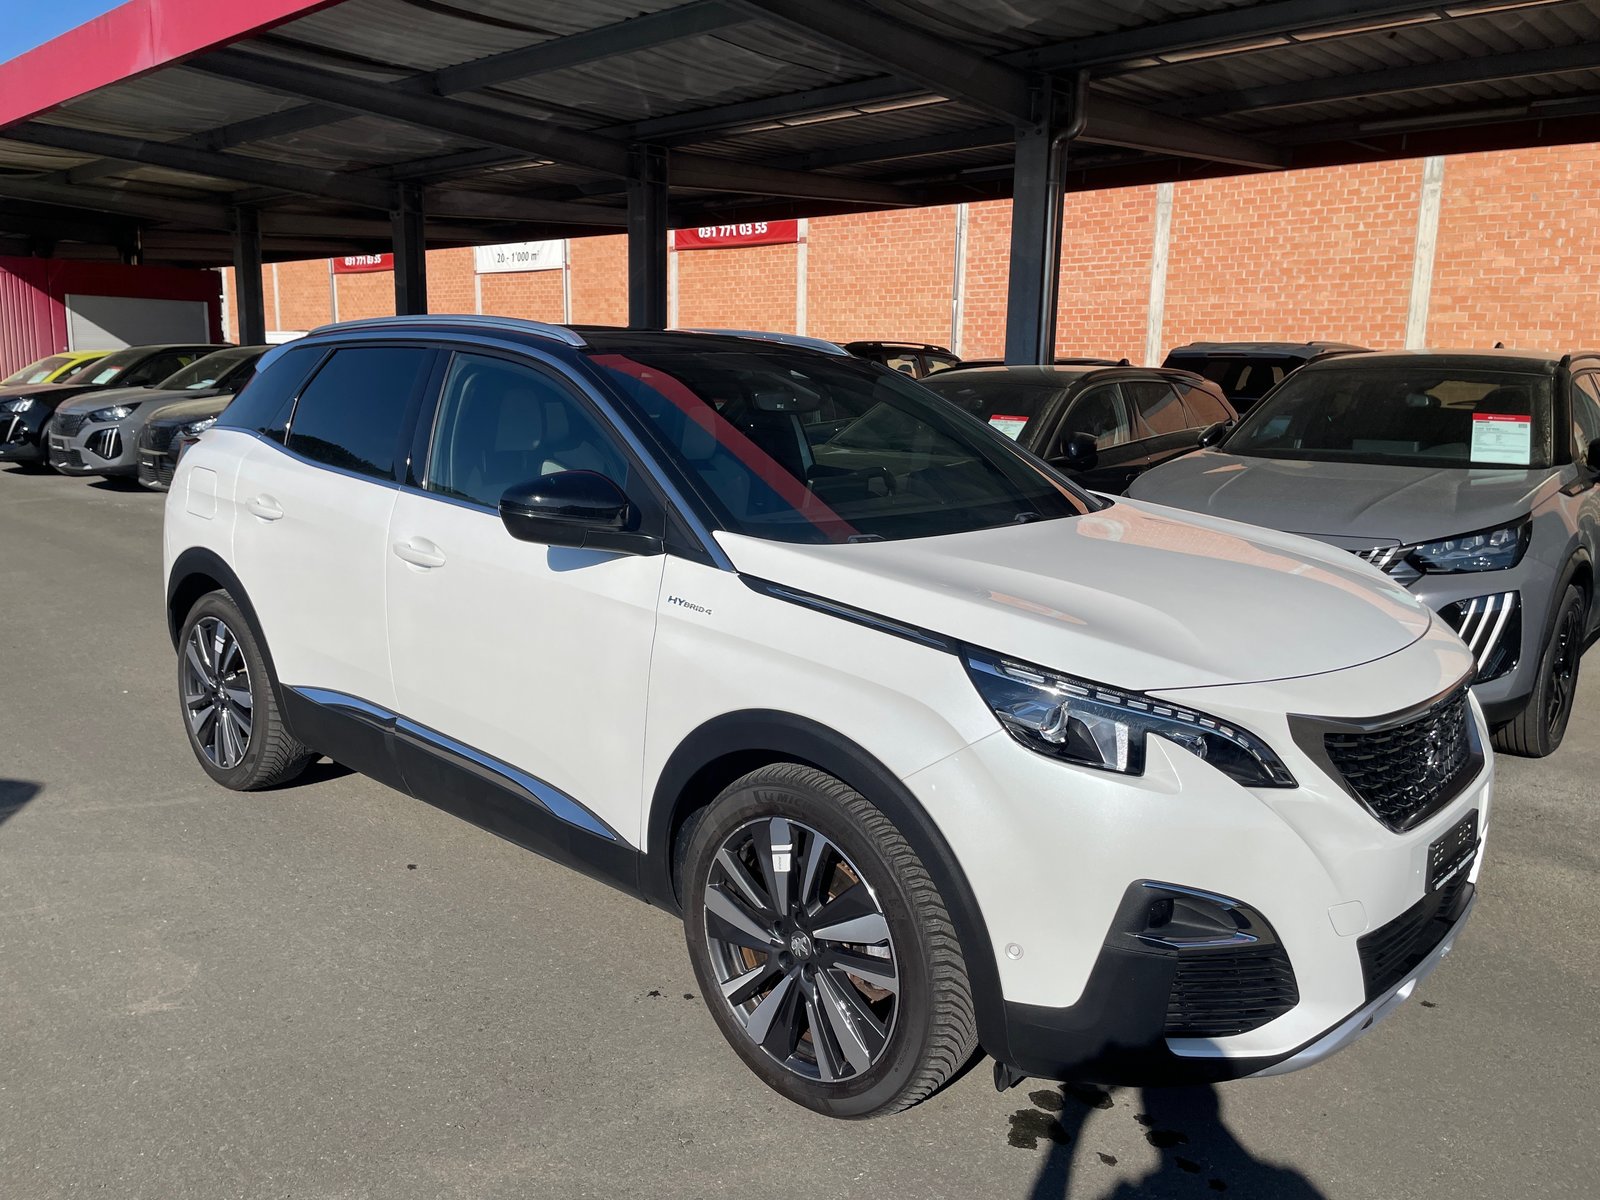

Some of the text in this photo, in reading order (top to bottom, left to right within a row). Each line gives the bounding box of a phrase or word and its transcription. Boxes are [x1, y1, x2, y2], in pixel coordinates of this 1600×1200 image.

[698, 221, 768, 238] 031 771 03 55
[497, 253, 505, 263] 20
